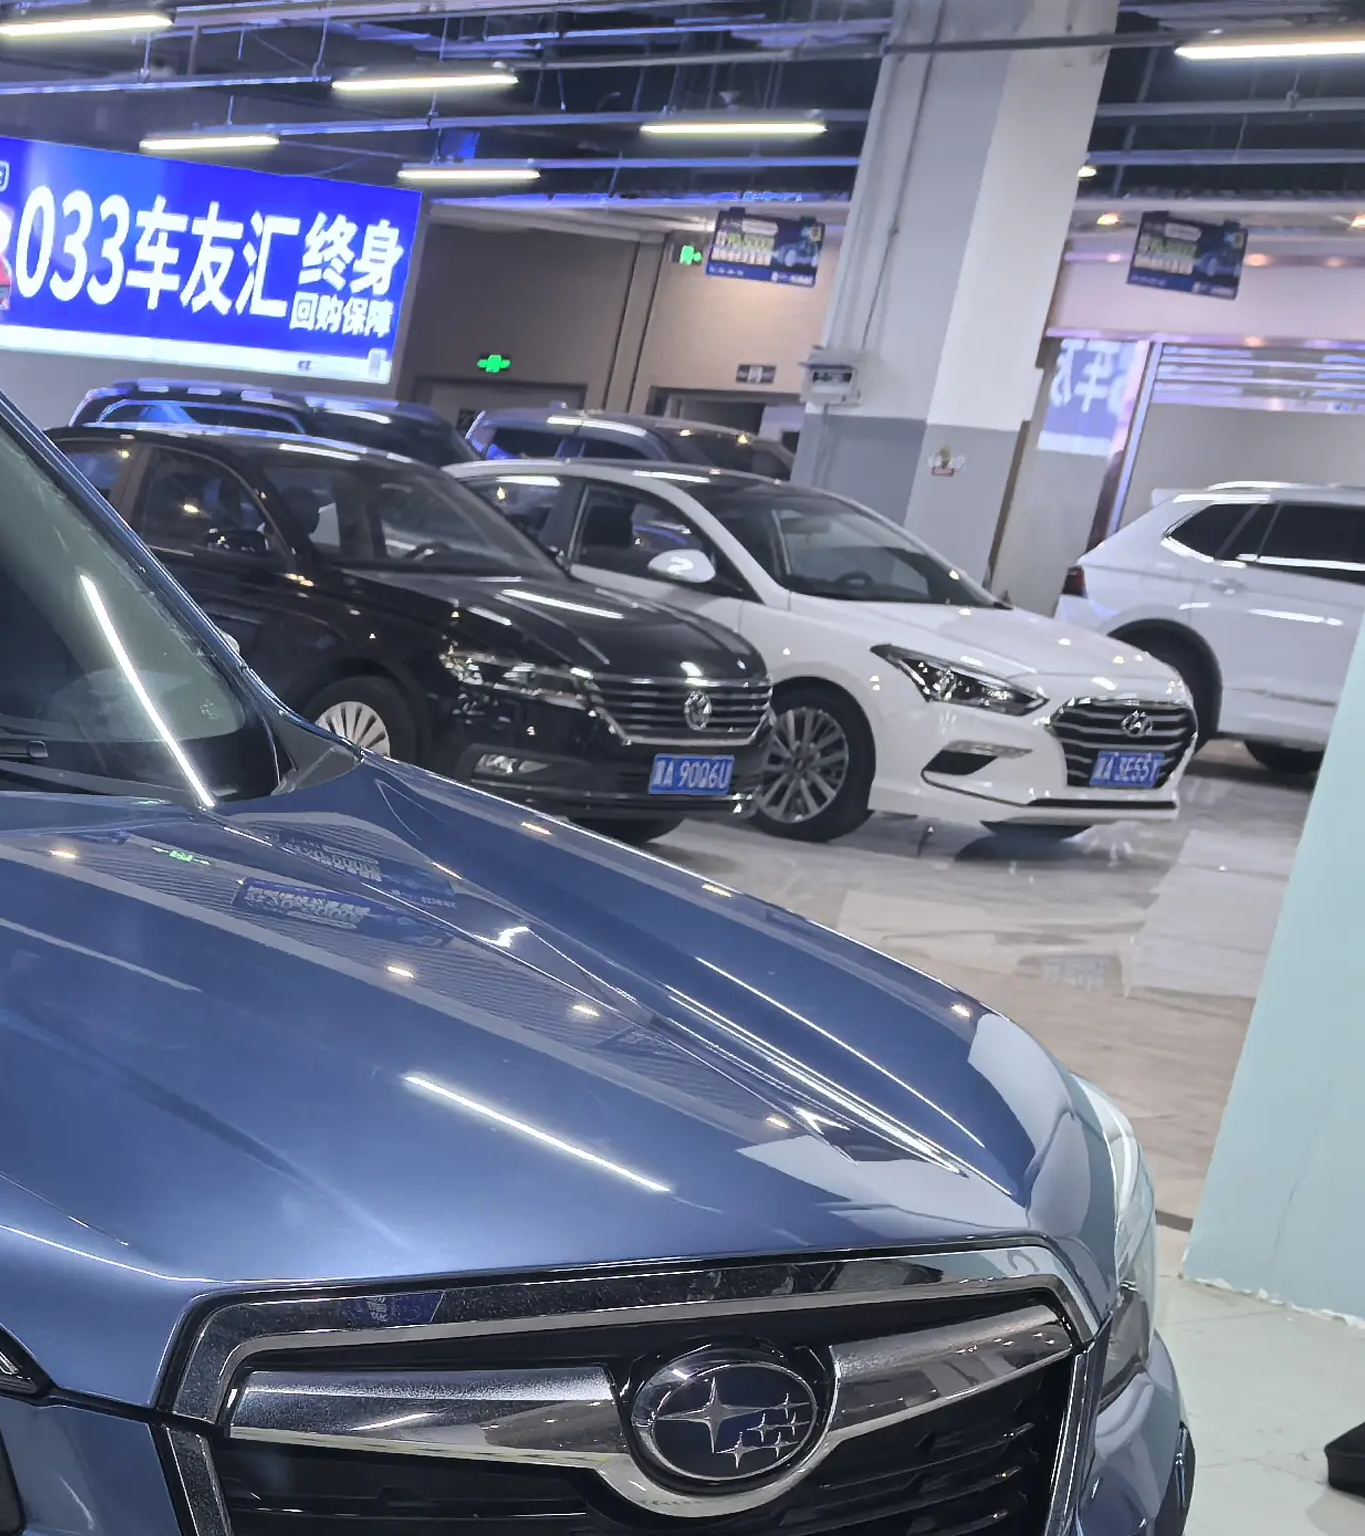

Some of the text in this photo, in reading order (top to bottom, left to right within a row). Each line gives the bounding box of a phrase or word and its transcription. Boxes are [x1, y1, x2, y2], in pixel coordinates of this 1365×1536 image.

[16, 185, 300, 318] 033车友汇
[298, 211, 404, 296] 终身
[290, 292, 393, 338] 回购保障
